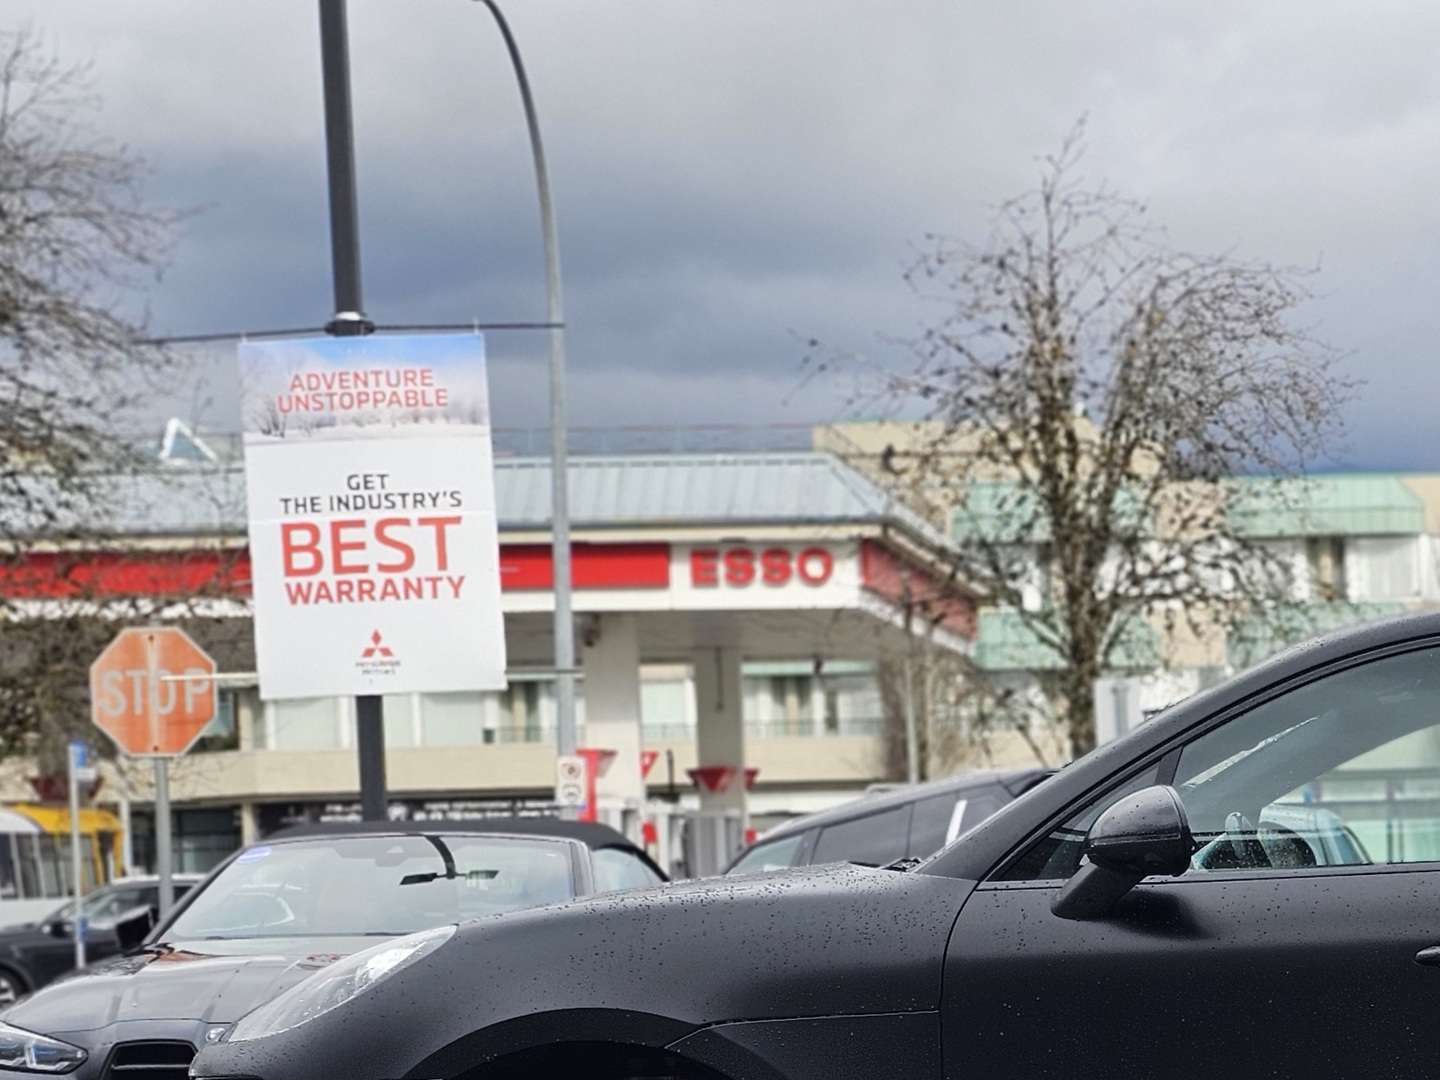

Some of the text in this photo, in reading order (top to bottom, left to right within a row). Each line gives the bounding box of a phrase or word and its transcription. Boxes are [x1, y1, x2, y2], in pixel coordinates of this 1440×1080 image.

[290, 368, 433, 391] ADVENTURE
[278, 388, 448, 413] UNSTOPPABLE
[347, 474, 389, 490] GET
[280, 491, 462, 514] THE INDUSTRY'S
[281, 516, 463, 577] BEST
[690, 547, 832, 588] ESSO
[285, 575, 465, 606] WARRANTY
[99, 667, 210, 716] STOP
